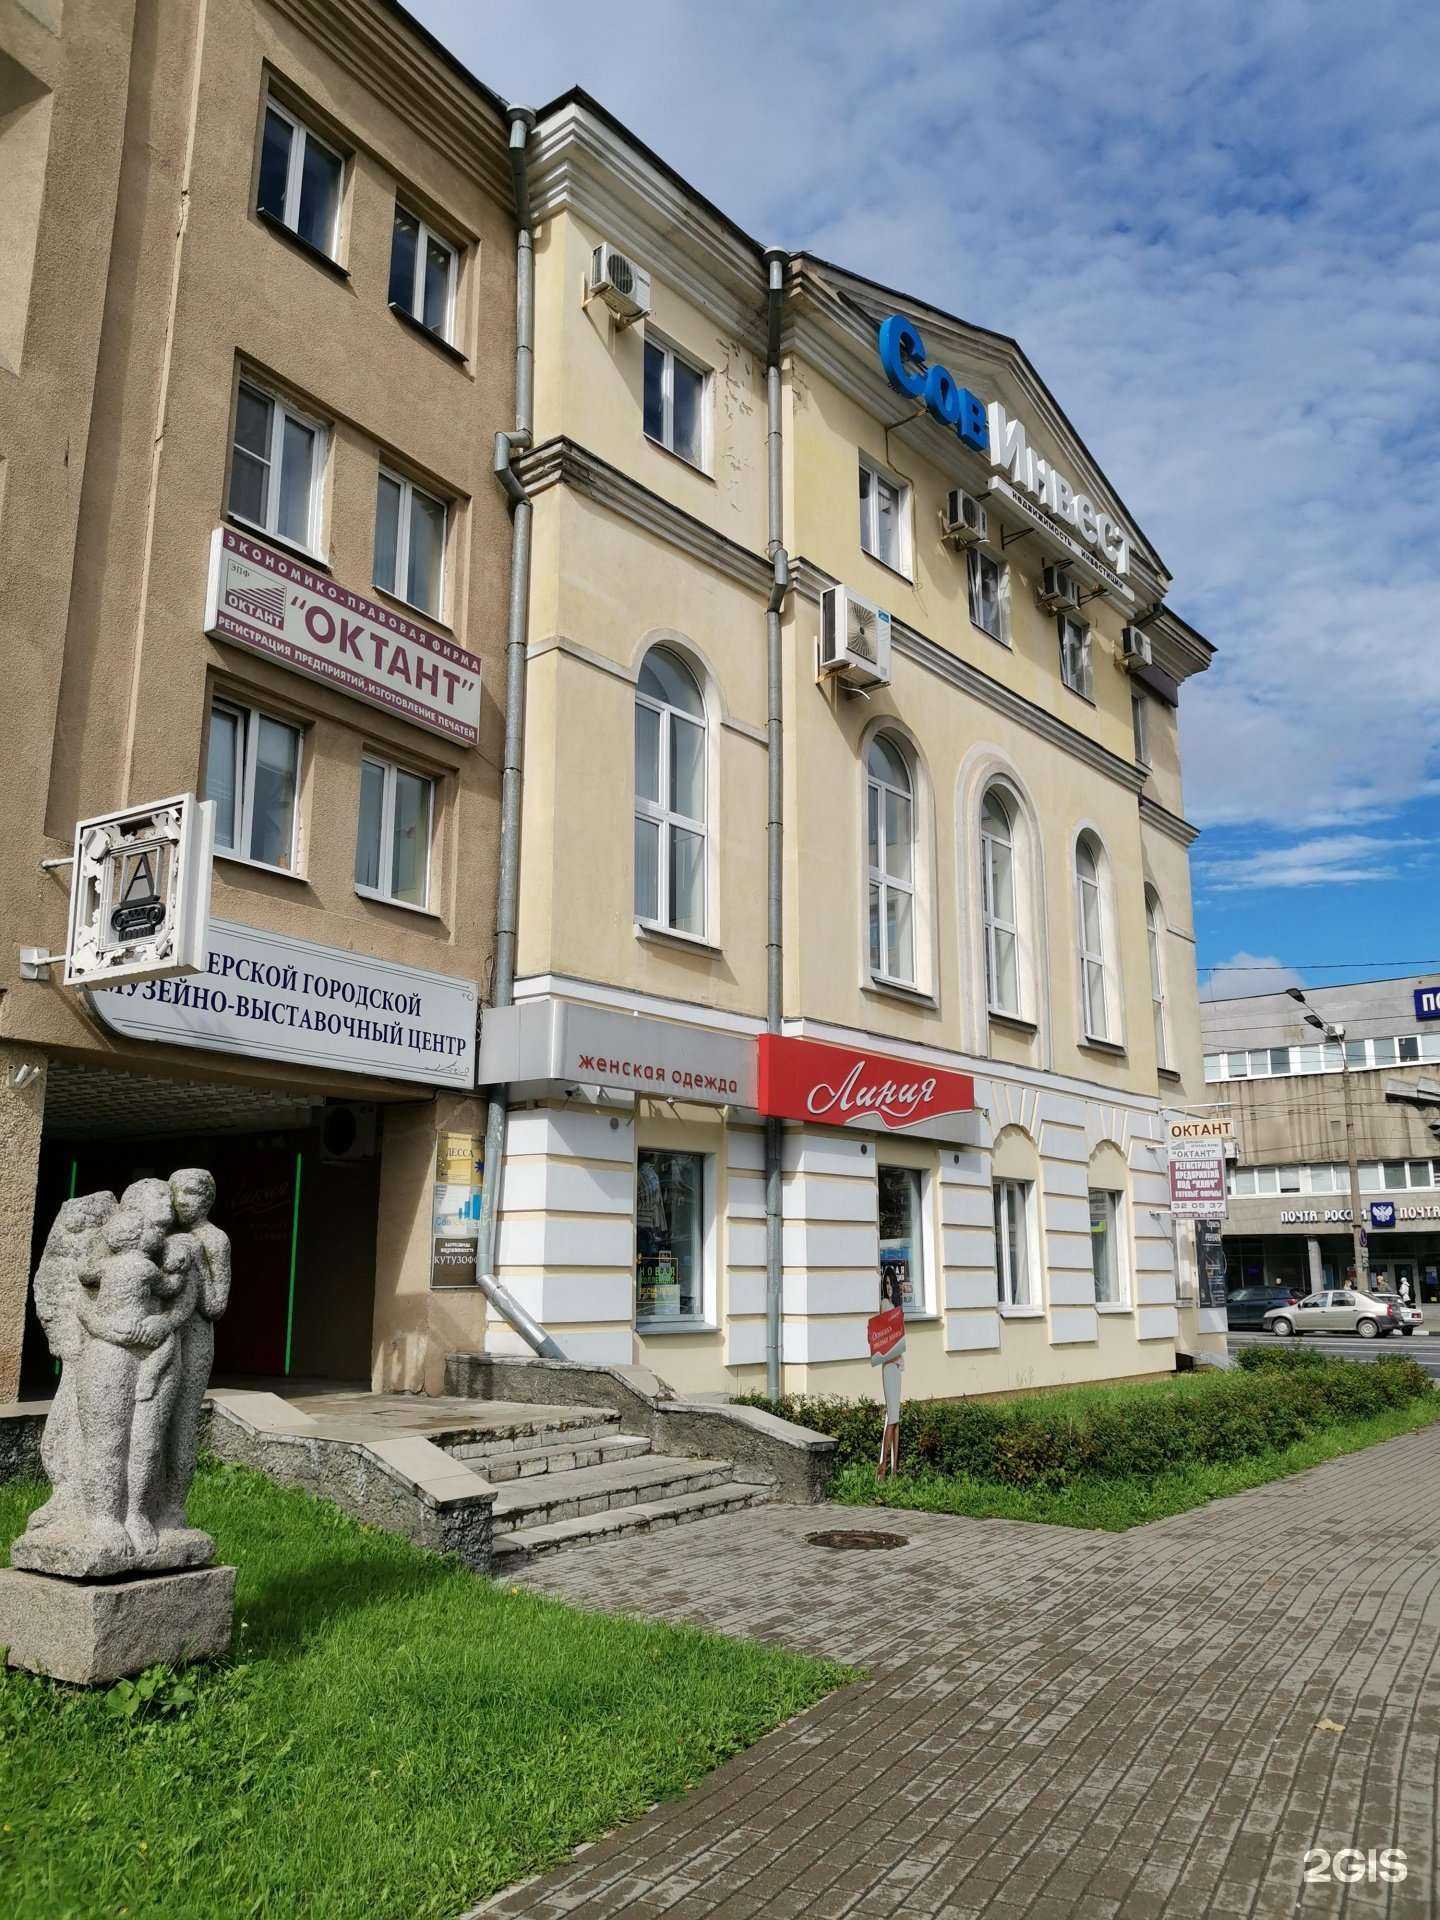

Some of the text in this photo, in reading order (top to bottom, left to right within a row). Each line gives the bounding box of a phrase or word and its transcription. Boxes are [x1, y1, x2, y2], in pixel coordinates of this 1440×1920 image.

[1012, 491, 1124, 589] НЕДВИЖИМОСТЬ ИНВЕСТИЦИИ
[230, 562, 250, 578] ЭПФ
[227, 535, 480, 672] ЭКОНОМИКО-ПРАВОВАЯ ФИРМА
[228, 594, 281, 628] ОКТАНТ
[291, 596, 475, 705] "ОКТАНТ"
[218, 615, 292, 656] РЕГИСТРАЦИЯ
[437, 716, 476, 739] ПЕЧАТЕЙ
[207, 951, 422, 1017] ЕРСКОЙ ГОРОДСКОЙ
[408, 1028, 467, 1057] ЦЕНТР
[578, 1054, 738, 1093] женская одежда
[807, 1060, 937, 1118] Линия
[1171, 1122, 1231, 1138] ОКТАНТ
[1280, 1208, 1367, 1223] ПОЧТА РОССИ
